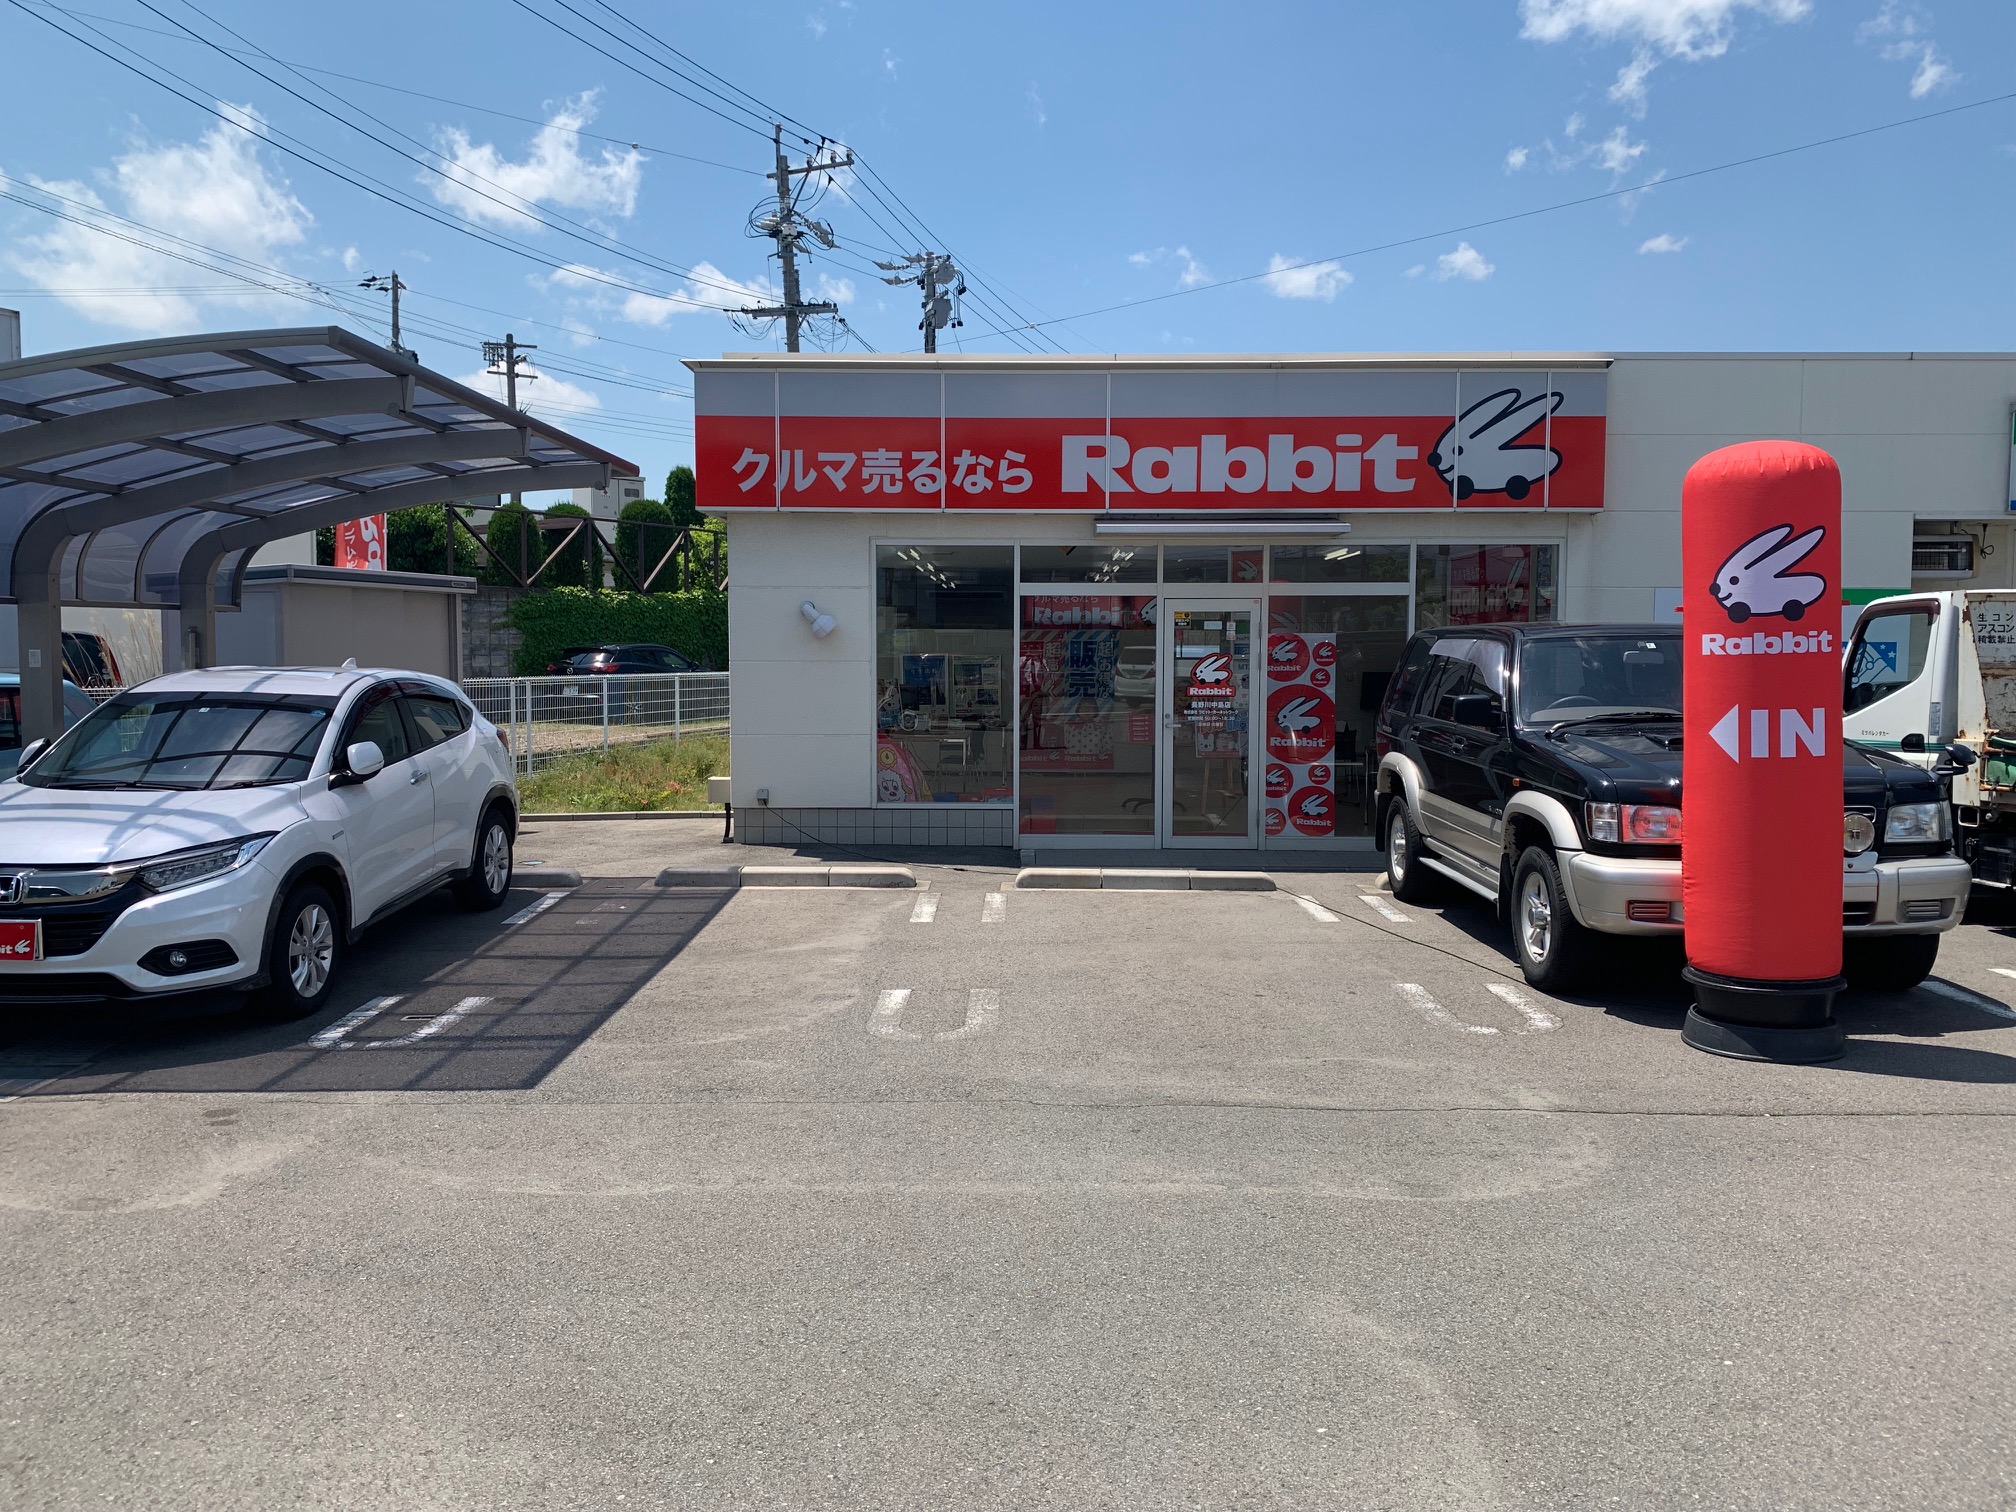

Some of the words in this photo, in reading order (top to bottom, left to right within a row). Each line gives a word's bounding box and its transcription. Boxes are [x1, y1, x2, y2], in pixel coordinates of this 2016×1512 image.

[731, 446, 1034, 496] クルマ売るなら
[1061, 432, 1419, 495] Rabbit
[1977, 623, 2015, 634] アスコン
[1702, 630, 1833, 656] Rabbit
[1069, 640, 1098, 697] 販売
[1267, 664, 1302, 672] Rabbit
[1189, 686, 1233, 696] Rabbit
[1750, 707, 1826, 759] IN
[1270, 736, 1326, 748] Rabbit
[1021, 754, 1048, 762] abbit
[1296, 818, 1332, 827] Rabbit
